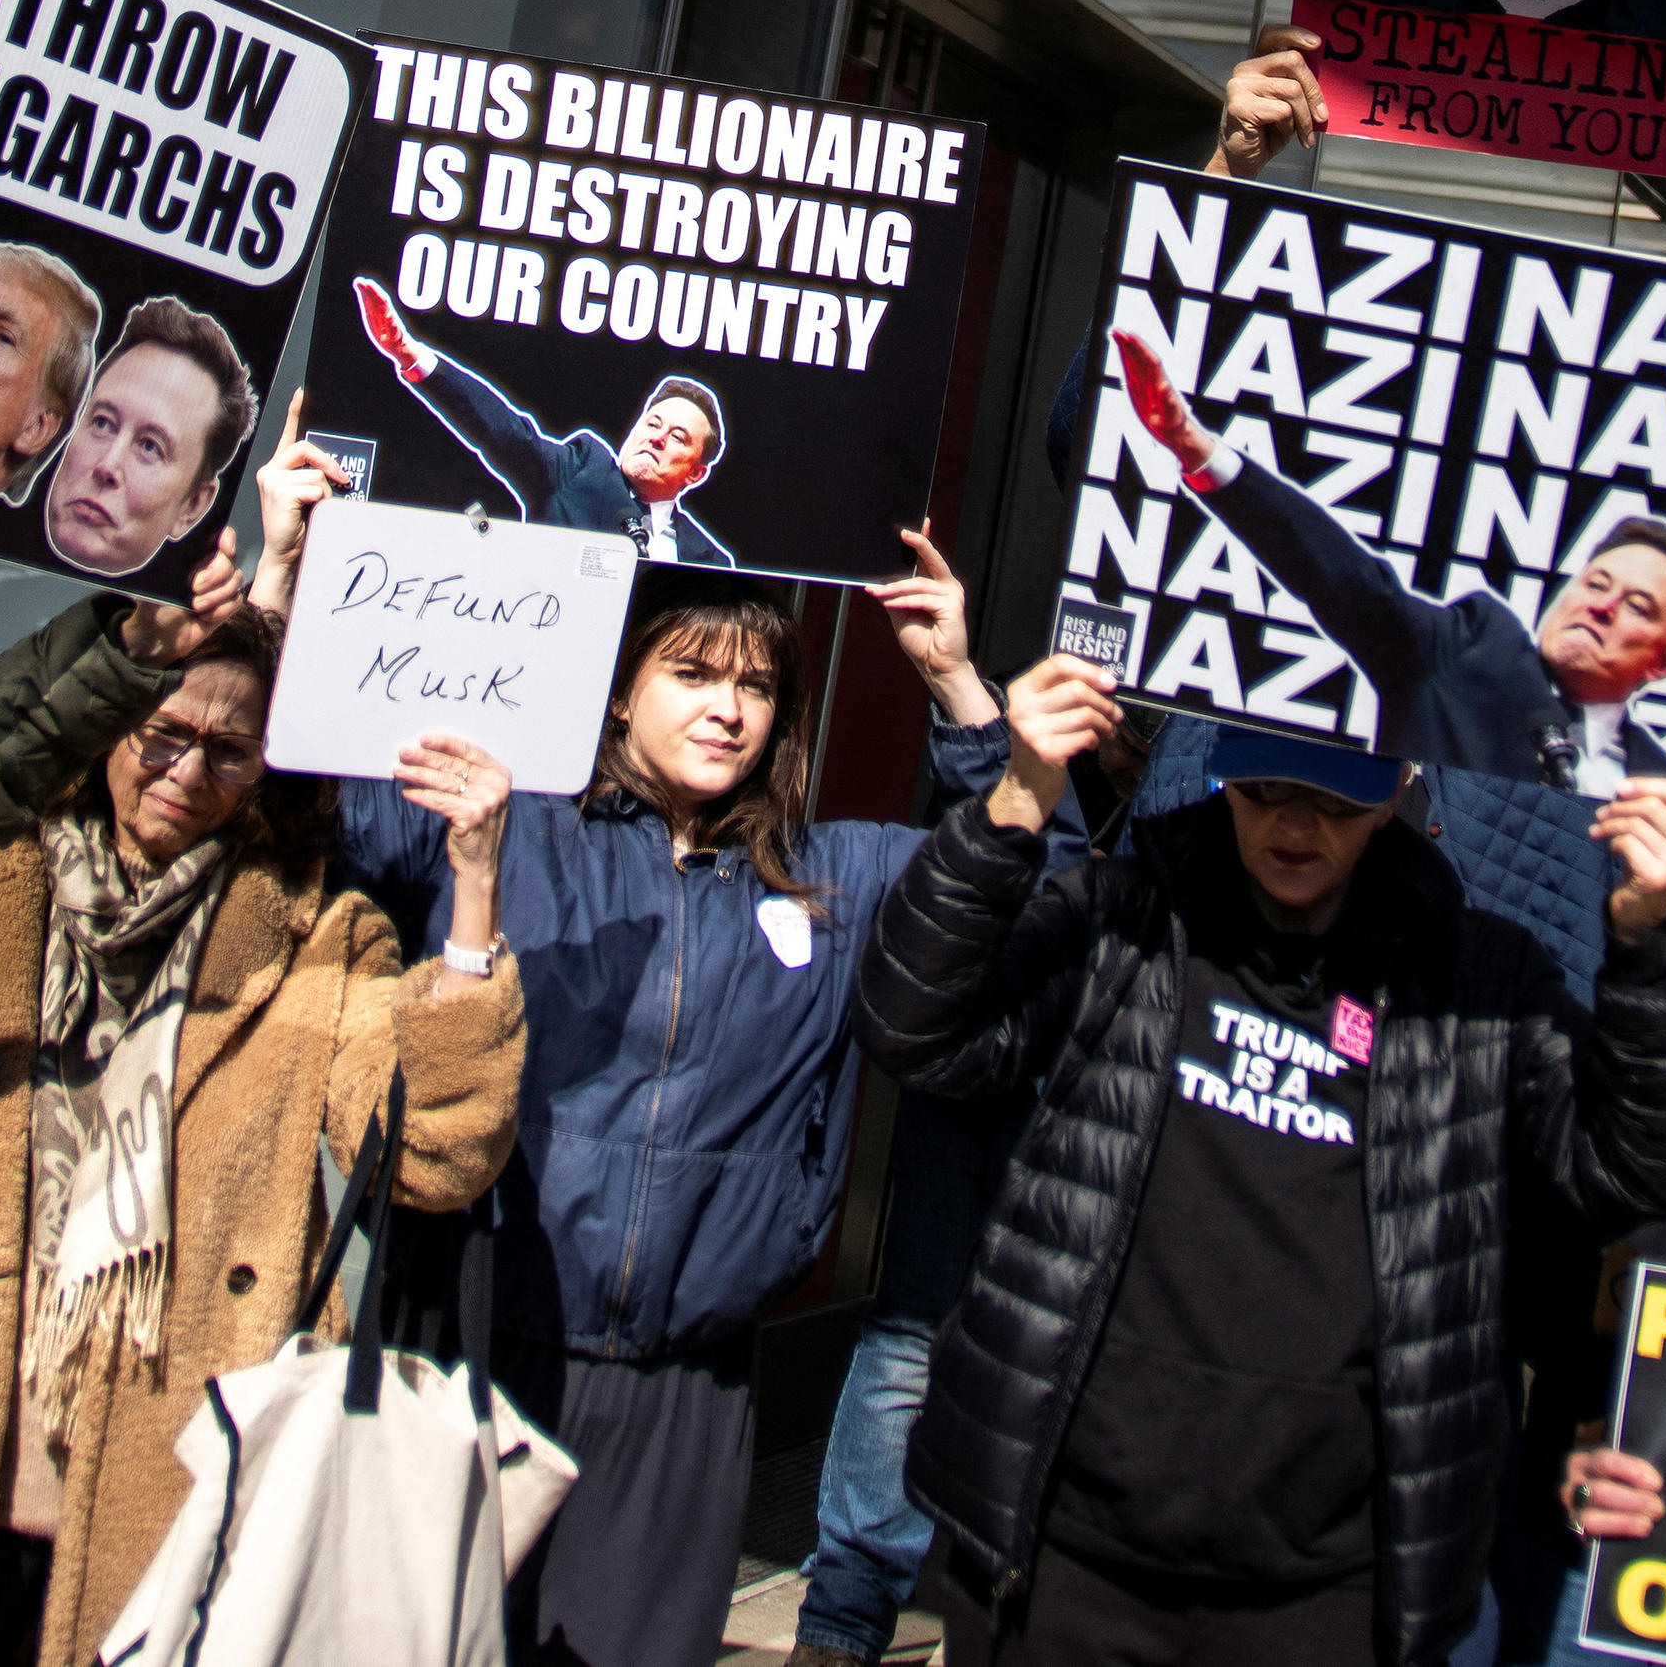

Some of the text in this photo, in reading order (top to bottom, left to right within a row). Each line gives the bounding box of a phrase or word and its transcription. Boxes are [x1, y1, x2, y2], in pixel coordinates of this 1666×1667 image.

[372, 43, 966, 205] THIS BILLIONAIRE
[1360, 80, 1524, 144] FROM
[390, 140, 915, 288] IS DESTROYING
[396, 232, 890, 372] OUR COUNTRY
[1119, 181, 1482, 344] NAZI
[1103, 285, 1460, 445] NAZI
[1060, 630, 1125, 663] RESIST
[1063, 615, 1127, 644] RISE AND
[1232, 1052, 1308, 1104] IS A
[1339, 1035, 1369, 1056] RIC
[1178, 1061, 1354, 1145] TRAITOR
